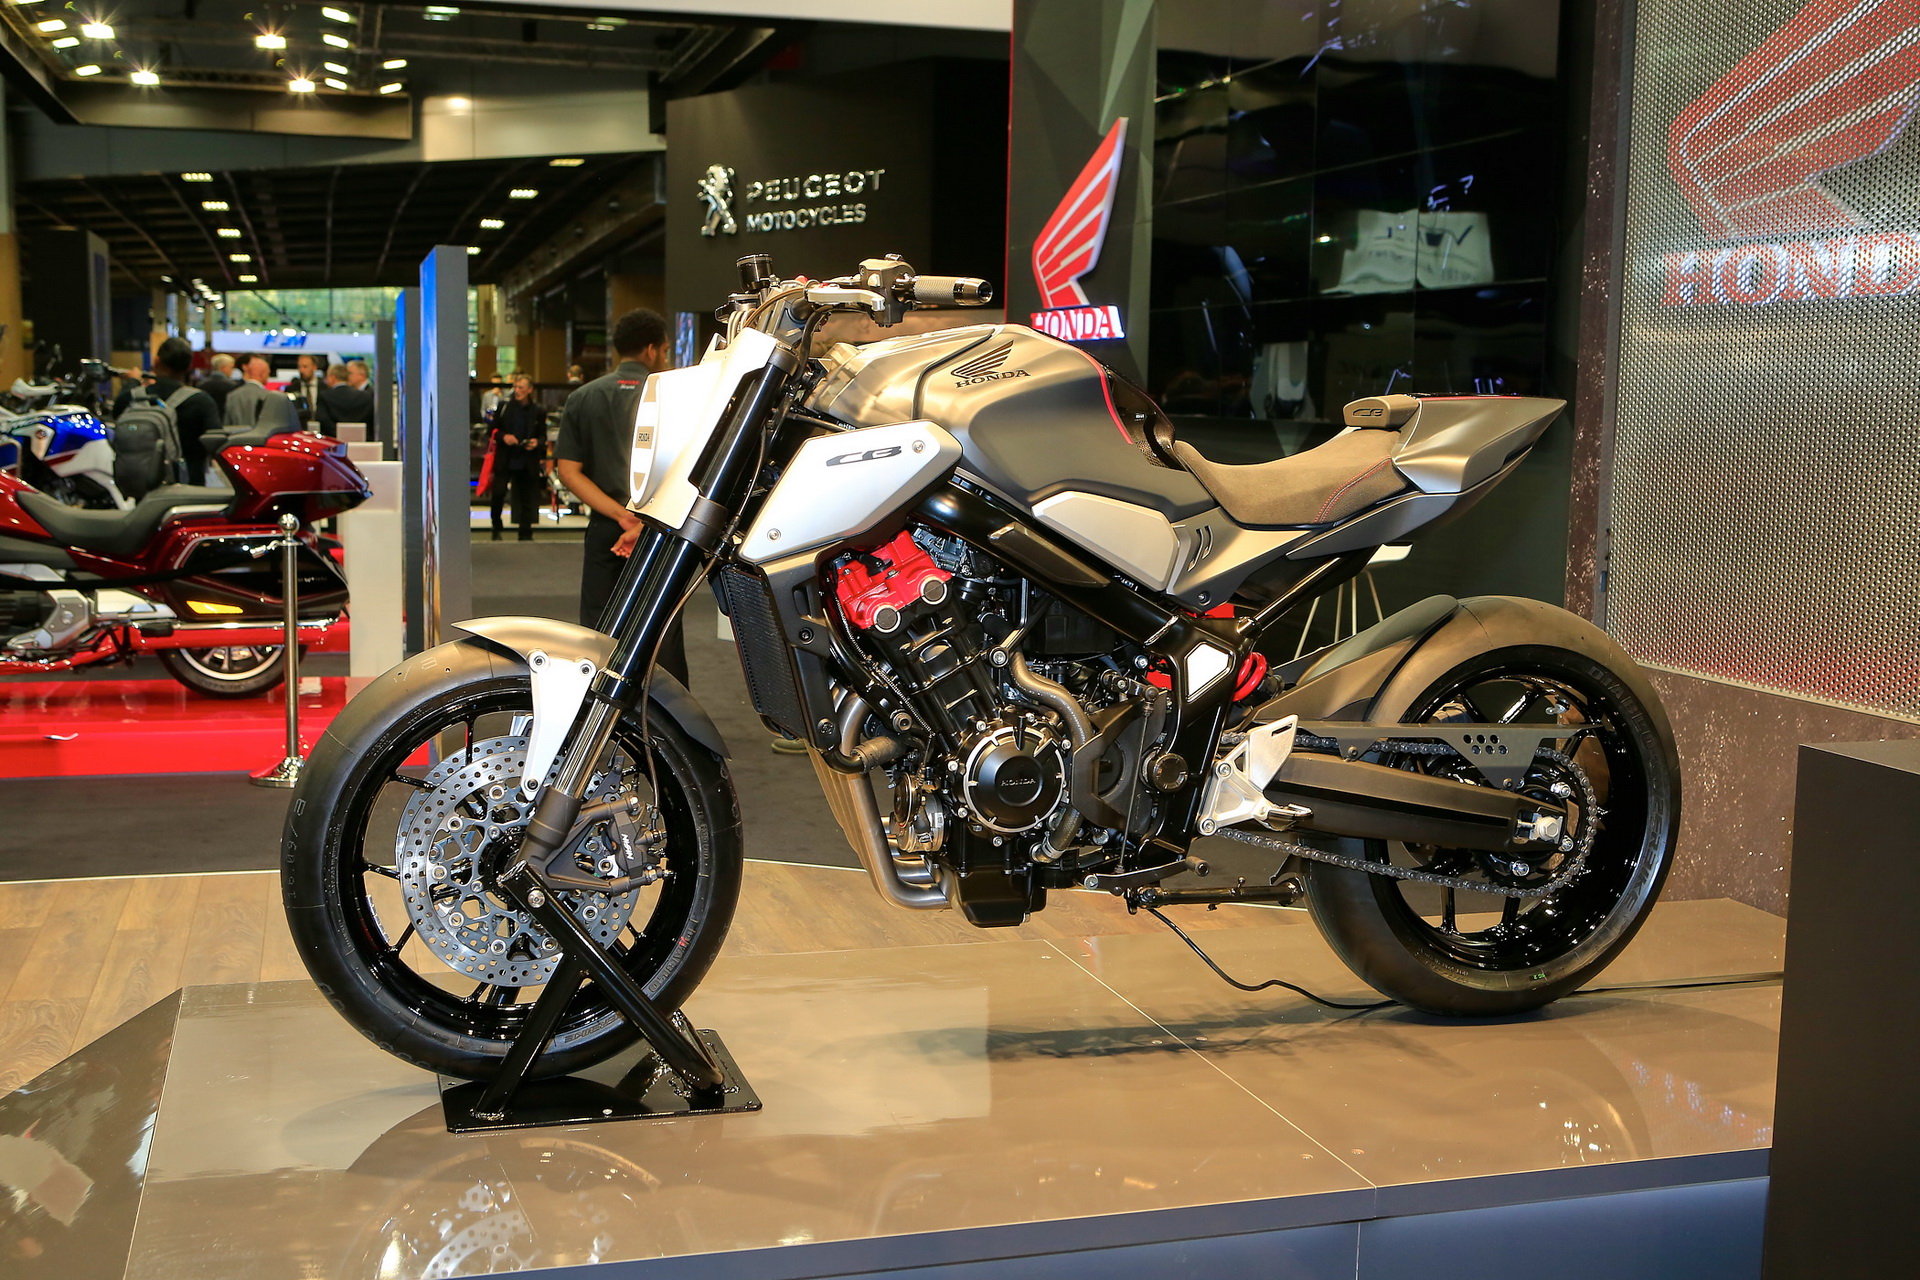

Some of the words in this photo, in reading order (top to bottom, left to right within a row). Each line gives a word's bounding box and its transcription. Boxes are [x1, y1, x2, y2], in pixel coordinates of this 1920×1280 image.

[746, 168, 886, 203] PEUGEOT
[746, 202, 867, 232] MOTOCYCLES
[1030, 305, 1116, 340] HONDA
[955, 369, 1031, 388] HONDA
[826, 445, 902, 467] CB
[1001, 778, 1036, 787] HONDA
